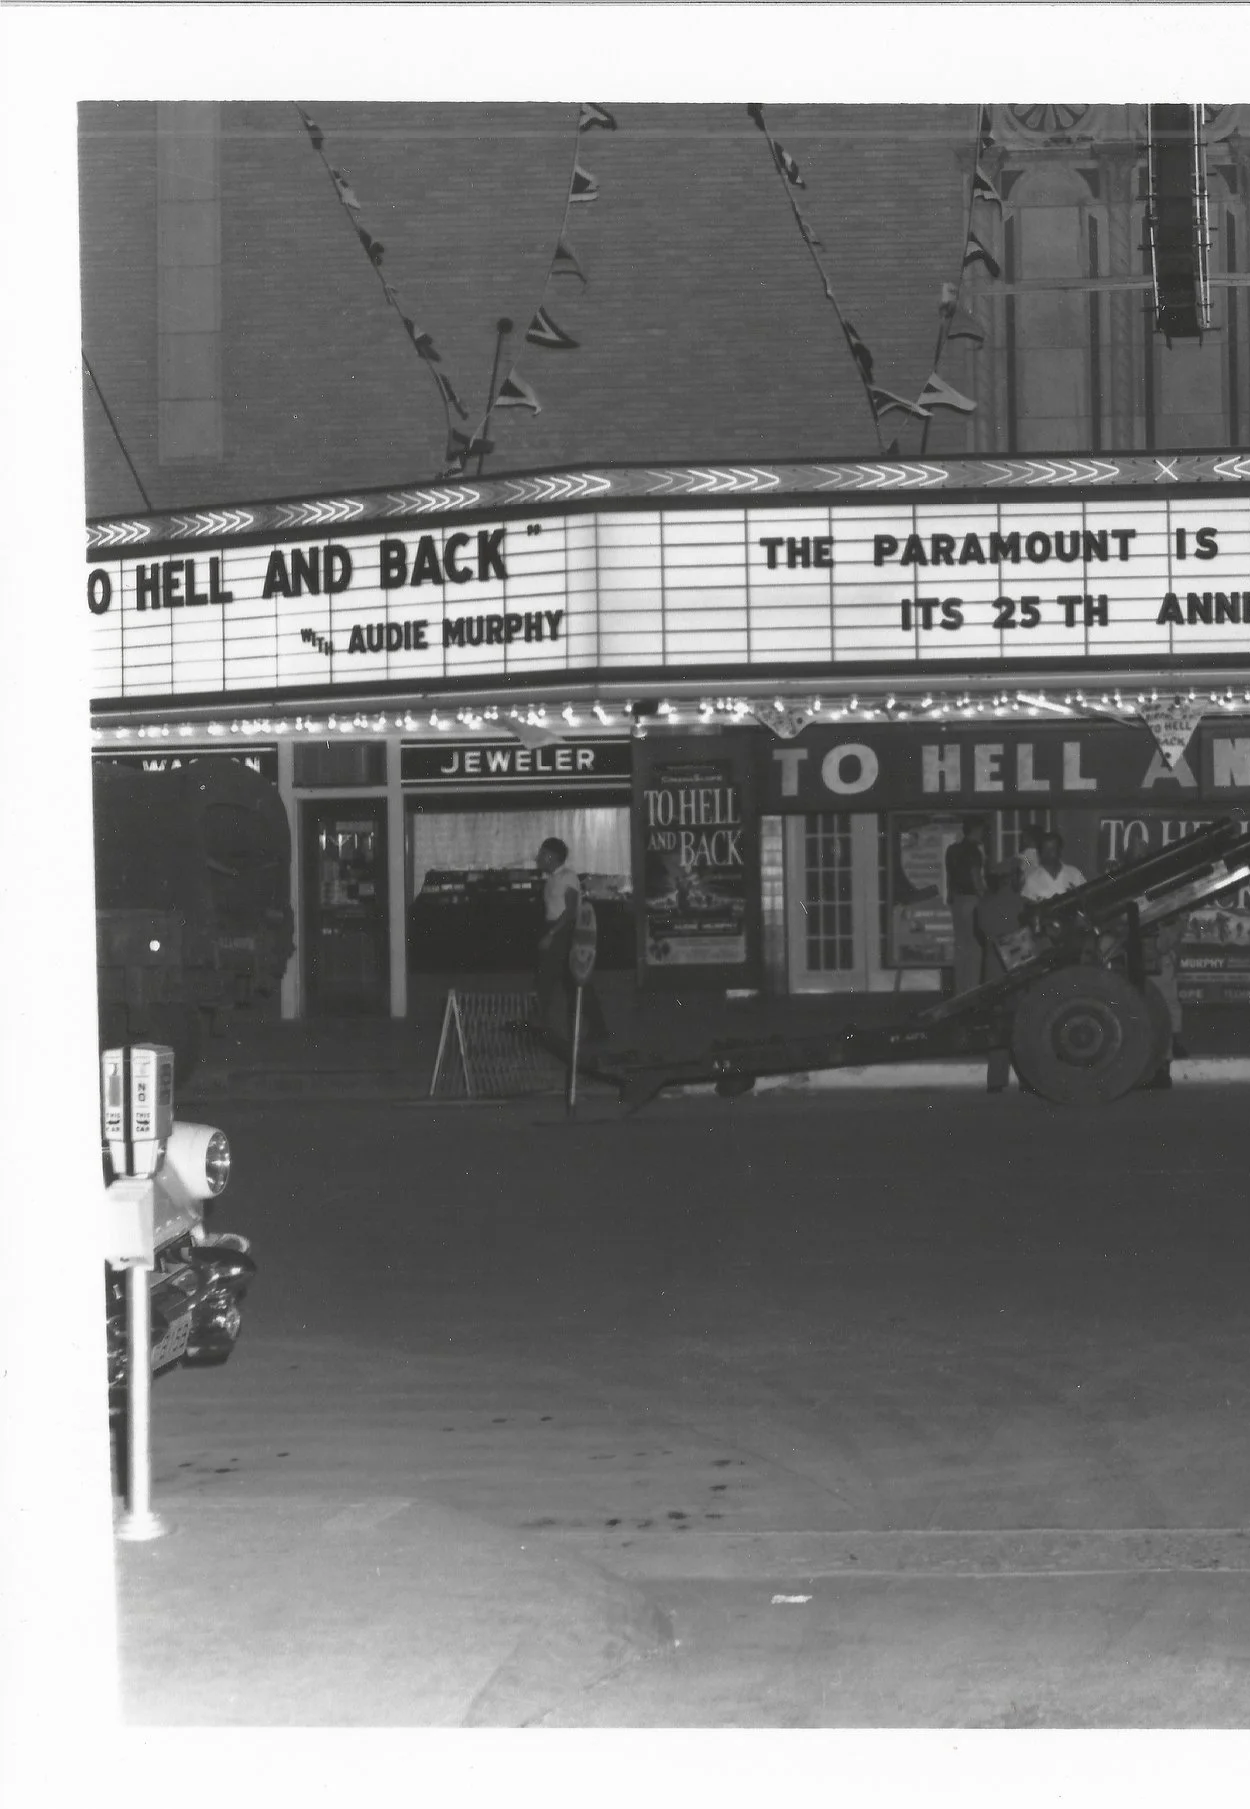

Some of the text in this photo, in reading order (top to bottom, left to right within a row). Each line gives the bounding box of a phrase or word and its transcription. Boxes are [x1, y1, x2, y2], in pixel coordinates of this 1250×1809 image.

[760, 536, 834, 569] THE
[873, 528, 1136, 567] PARAMOUNT
[1176, 527, 1219, 559] IS
[136, 556, 233, 611] HELL
[262, 545, 352, 600] AND
[300, 610, 562, 656] WITH AUDIE MURPHY
[901, 597, 965, 631] ITS
[991, 596, 1041, 629] 25
[1057, 595, 1109, 627] TH
[441, 749, 595, 774] JEWELER
[772, 743, 879, 795] TO
[921, 741, 1097, 794] HELL
[643, 787, 742, 827] TO HELL
[647, 829, 745, 867] AND BACK
